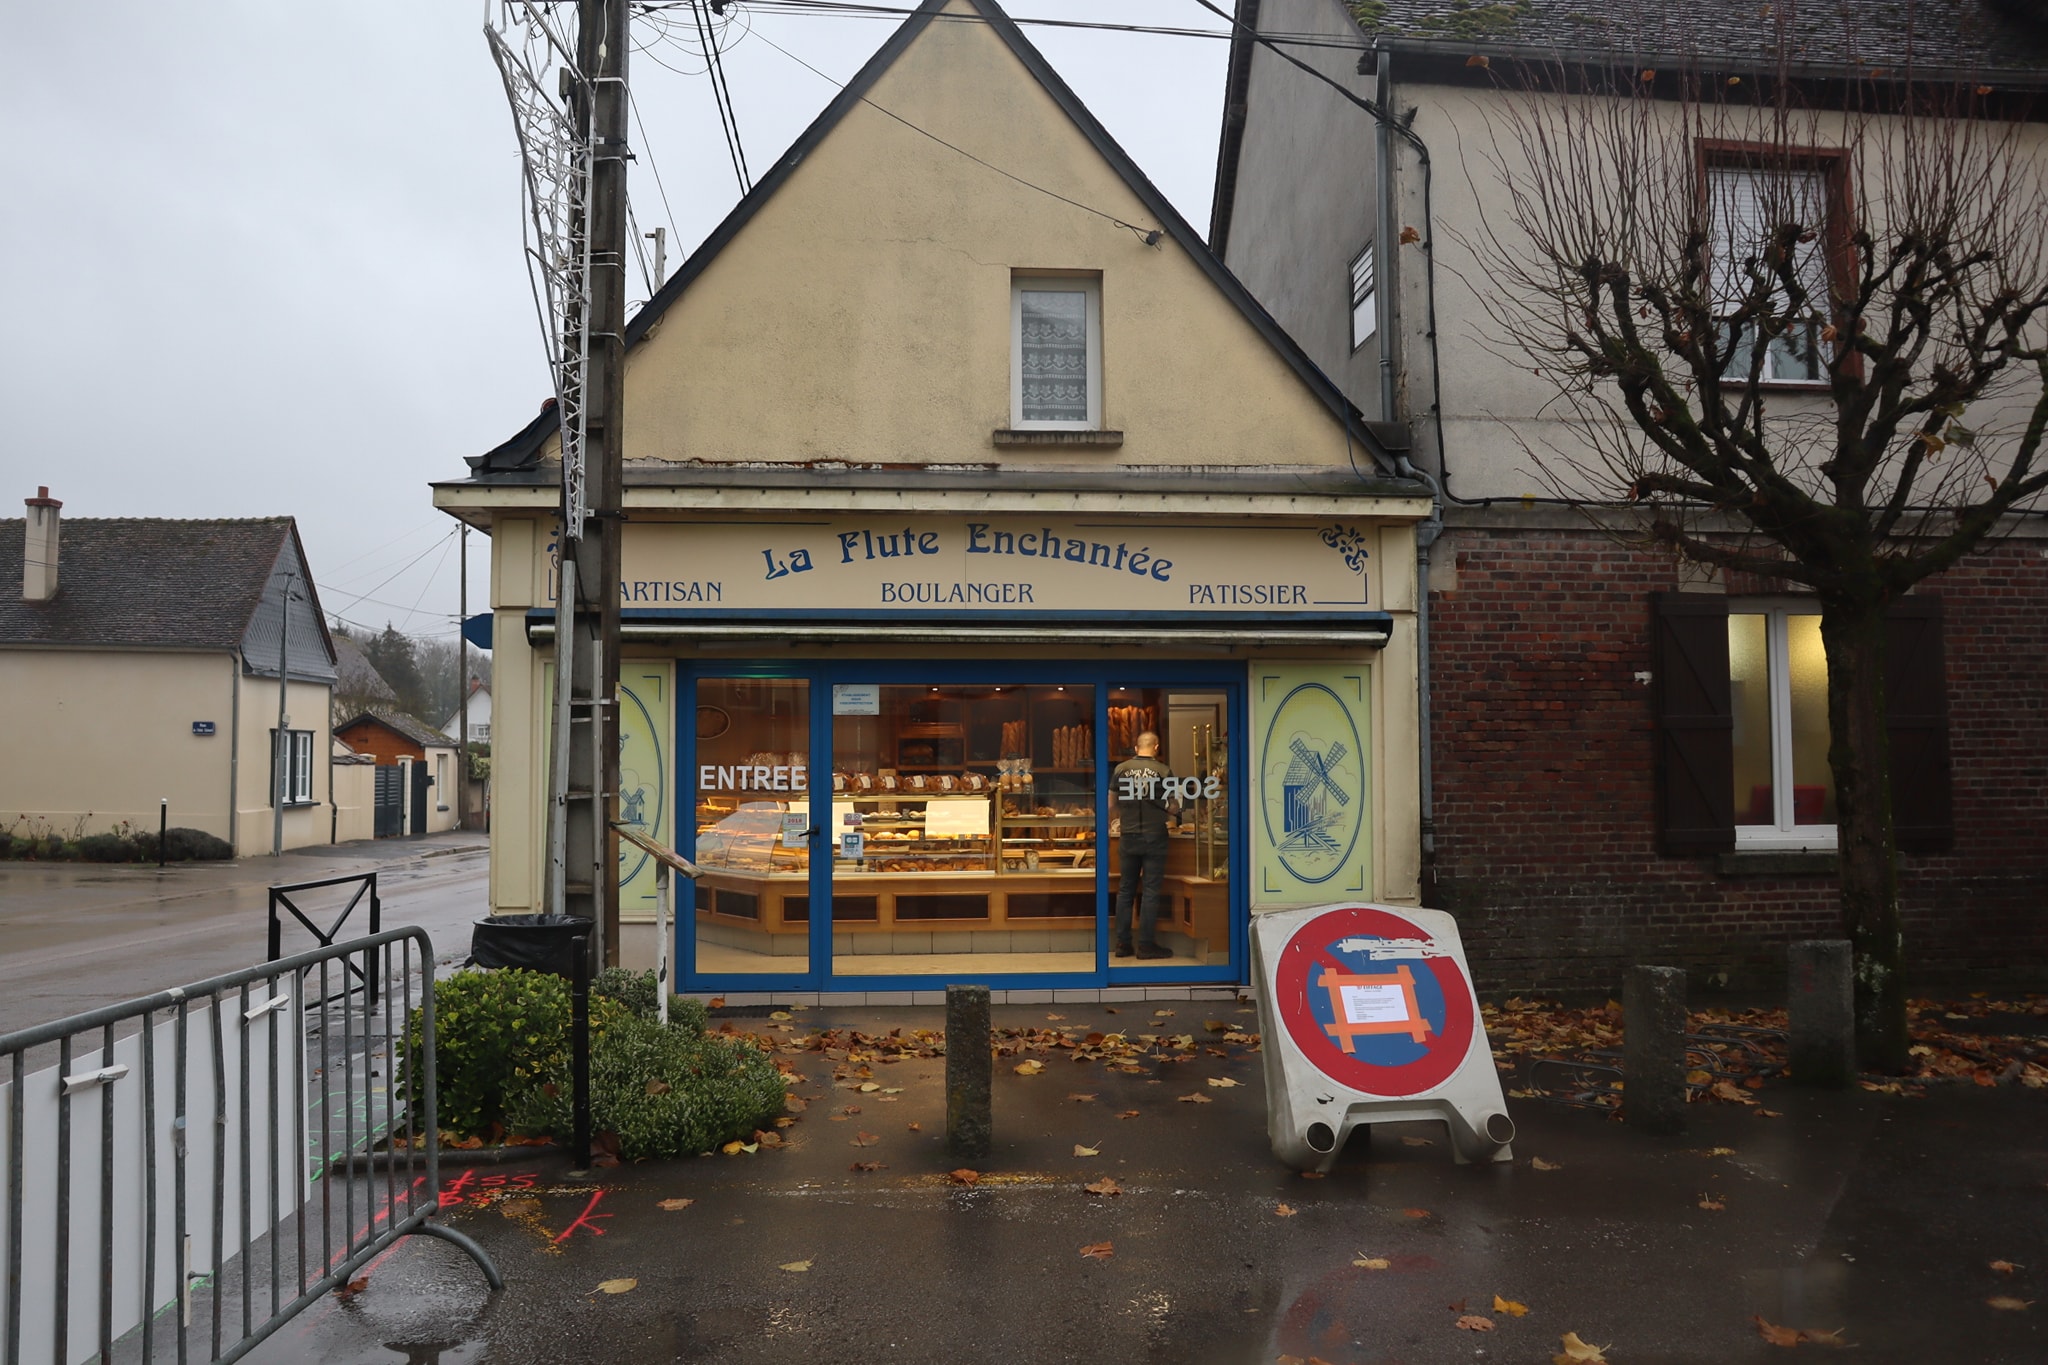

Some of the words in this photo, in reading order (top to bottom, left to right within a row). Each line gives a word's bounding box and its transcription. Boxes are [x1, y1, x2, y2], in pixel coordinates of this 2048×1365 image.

[764, 549, 814, 581] La
[839, 527, 940, 564] Flute
[967, 523, 1173, 583] Enchantée
[620, 581, 722, 602] ARTISAN
[881, 582, 1034, 603] BOULANGER
[1189, 585, 1308, 605] PATISSIER
[700, 765, 807, 791] ENTREE
